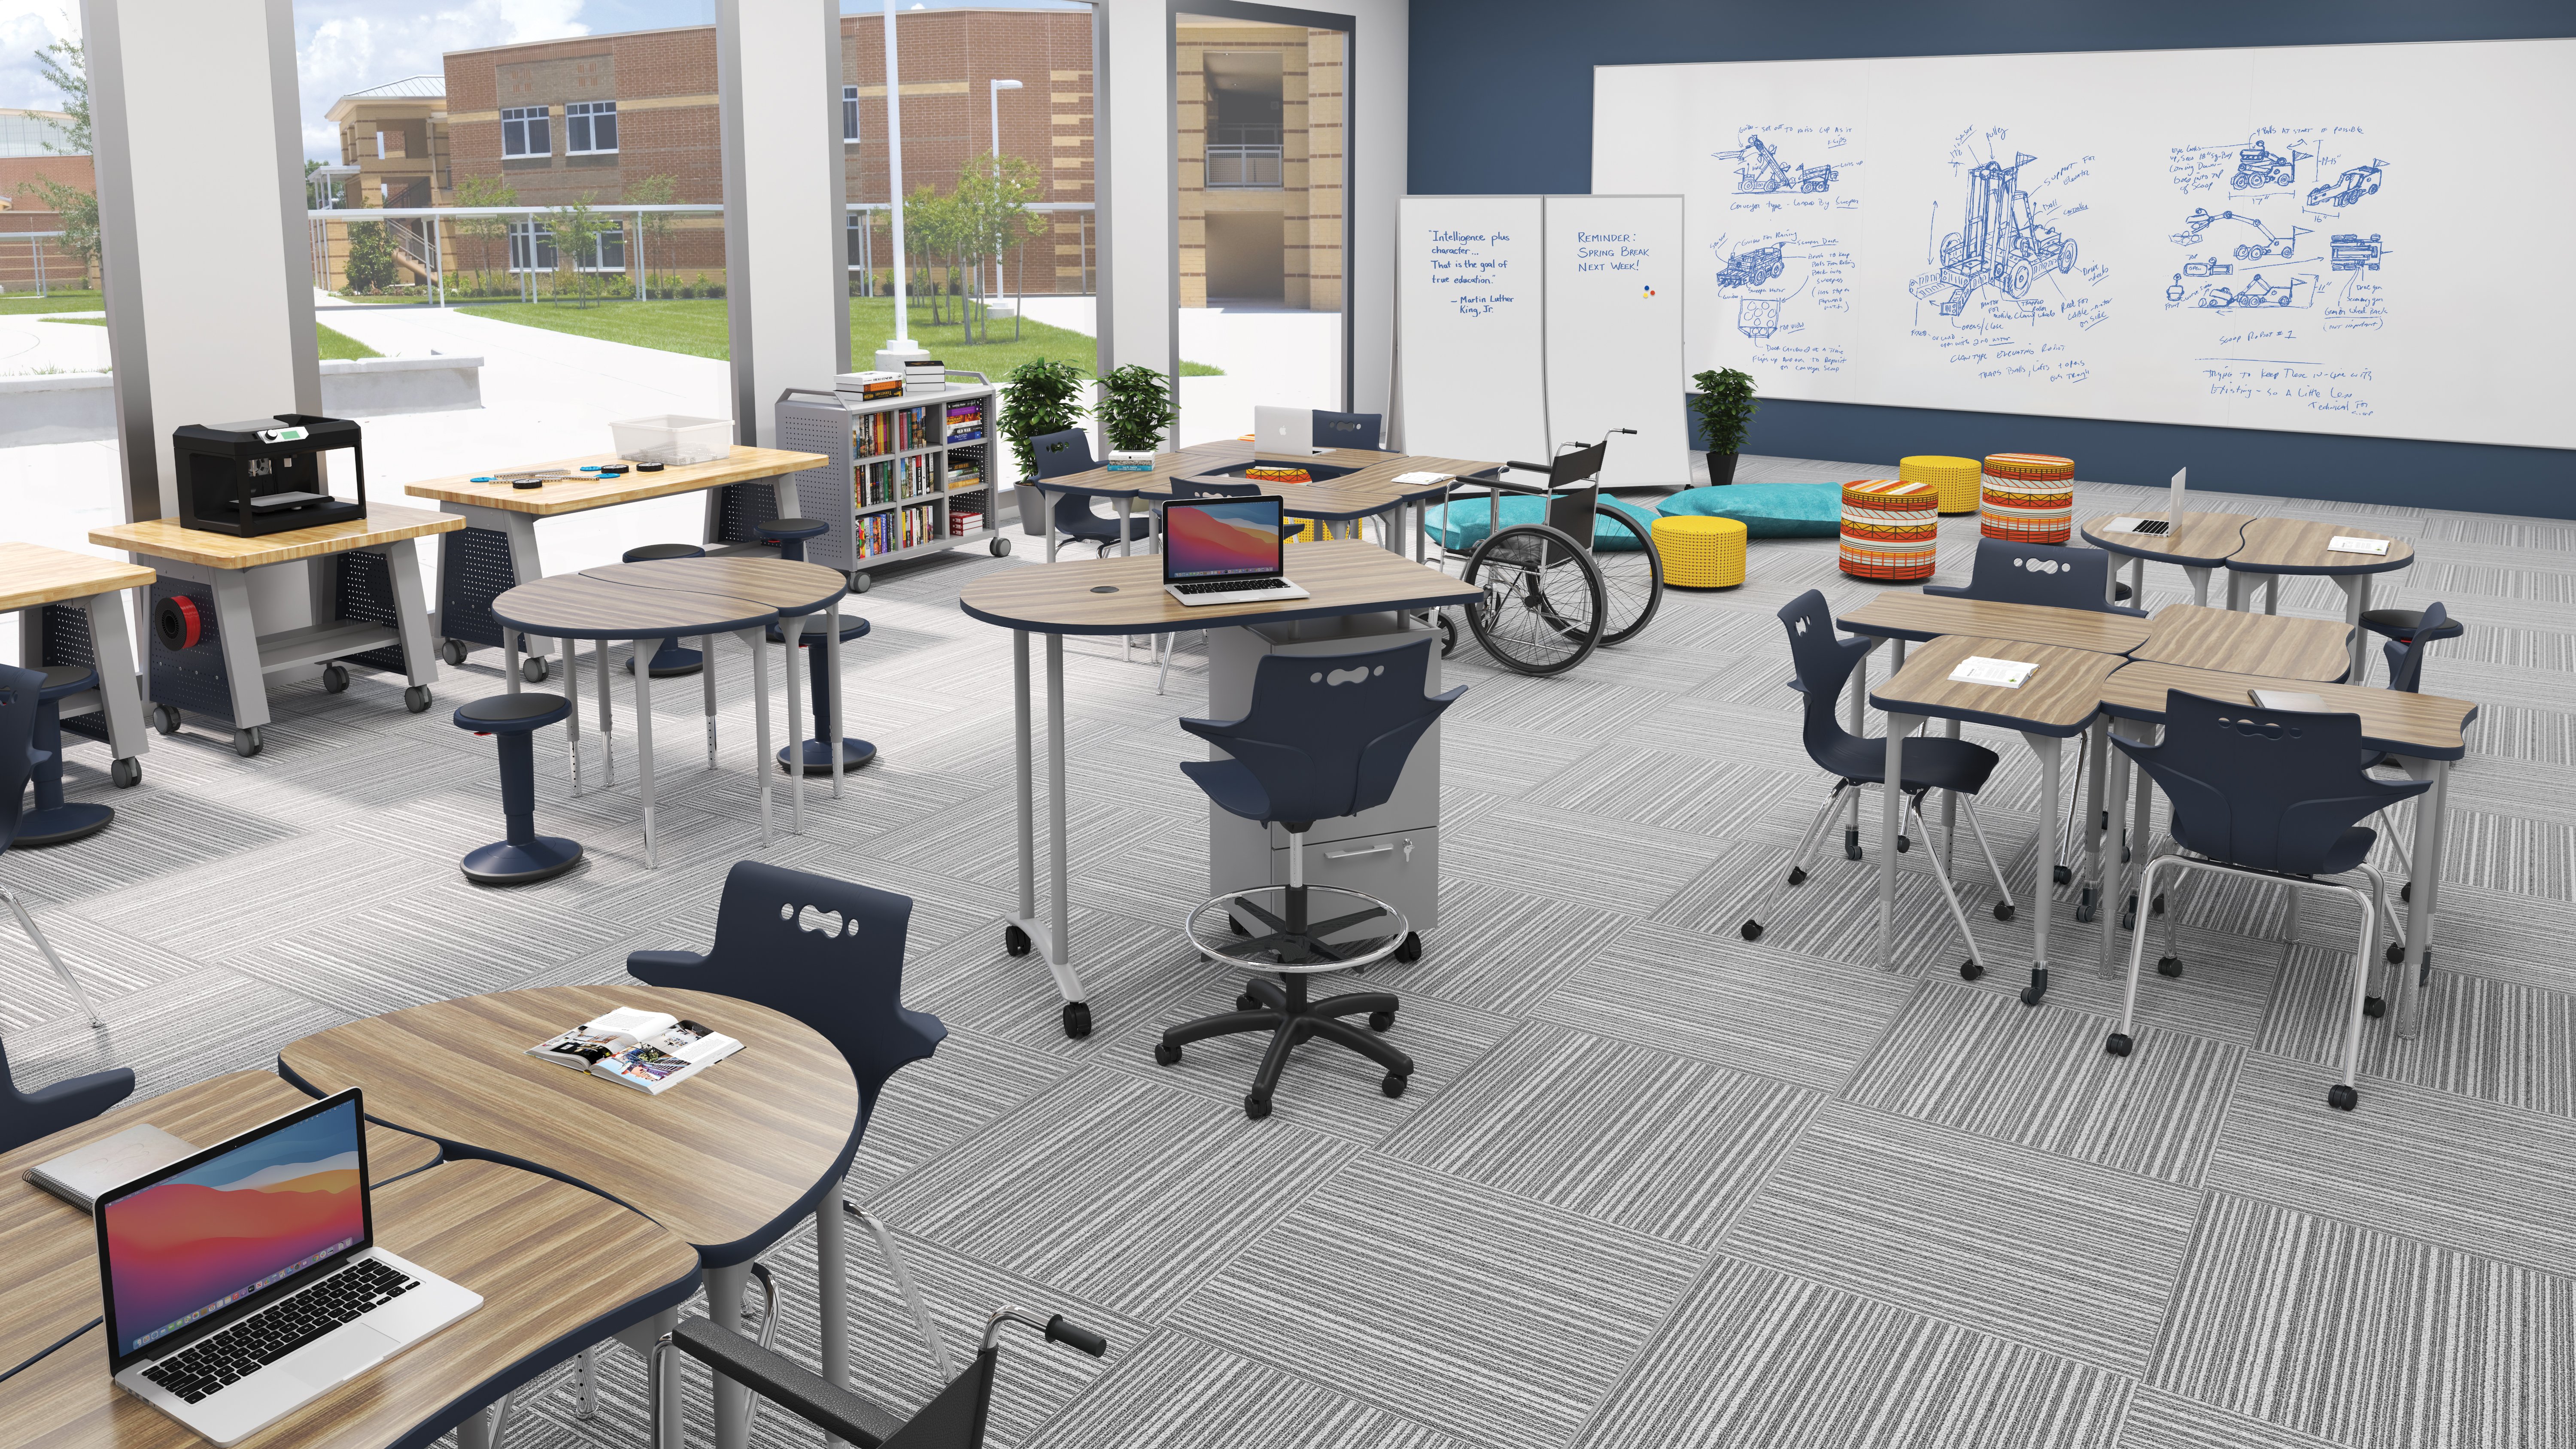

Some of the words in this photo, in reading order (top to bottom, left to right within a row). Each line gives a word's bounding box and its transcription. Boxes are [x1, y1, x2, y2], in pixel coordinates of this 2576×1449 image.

[1428, 229, 1485, 246] "Intelligence
[1491, 231, 1510, 246] plus
[1431, 260, 1452, 270] That
[1455, 260, 1462, 269] is
[1463, 260, 1478, 269] the
[1480, 260, 1496, 272] goal
[1498, 260, 1508, 269] of
[1578, 262, 1605, 272] NEXT
[1610, 260, 1640, 271] WEEK!
[1431, 275, 1450, 284] true
[1460, 295, 1487, 304] Martin
[1490, 295, 1514, 303] Luther
[1460, 305, 1481, 317] King,
[1482, 305, 1494, 314] Jr.
